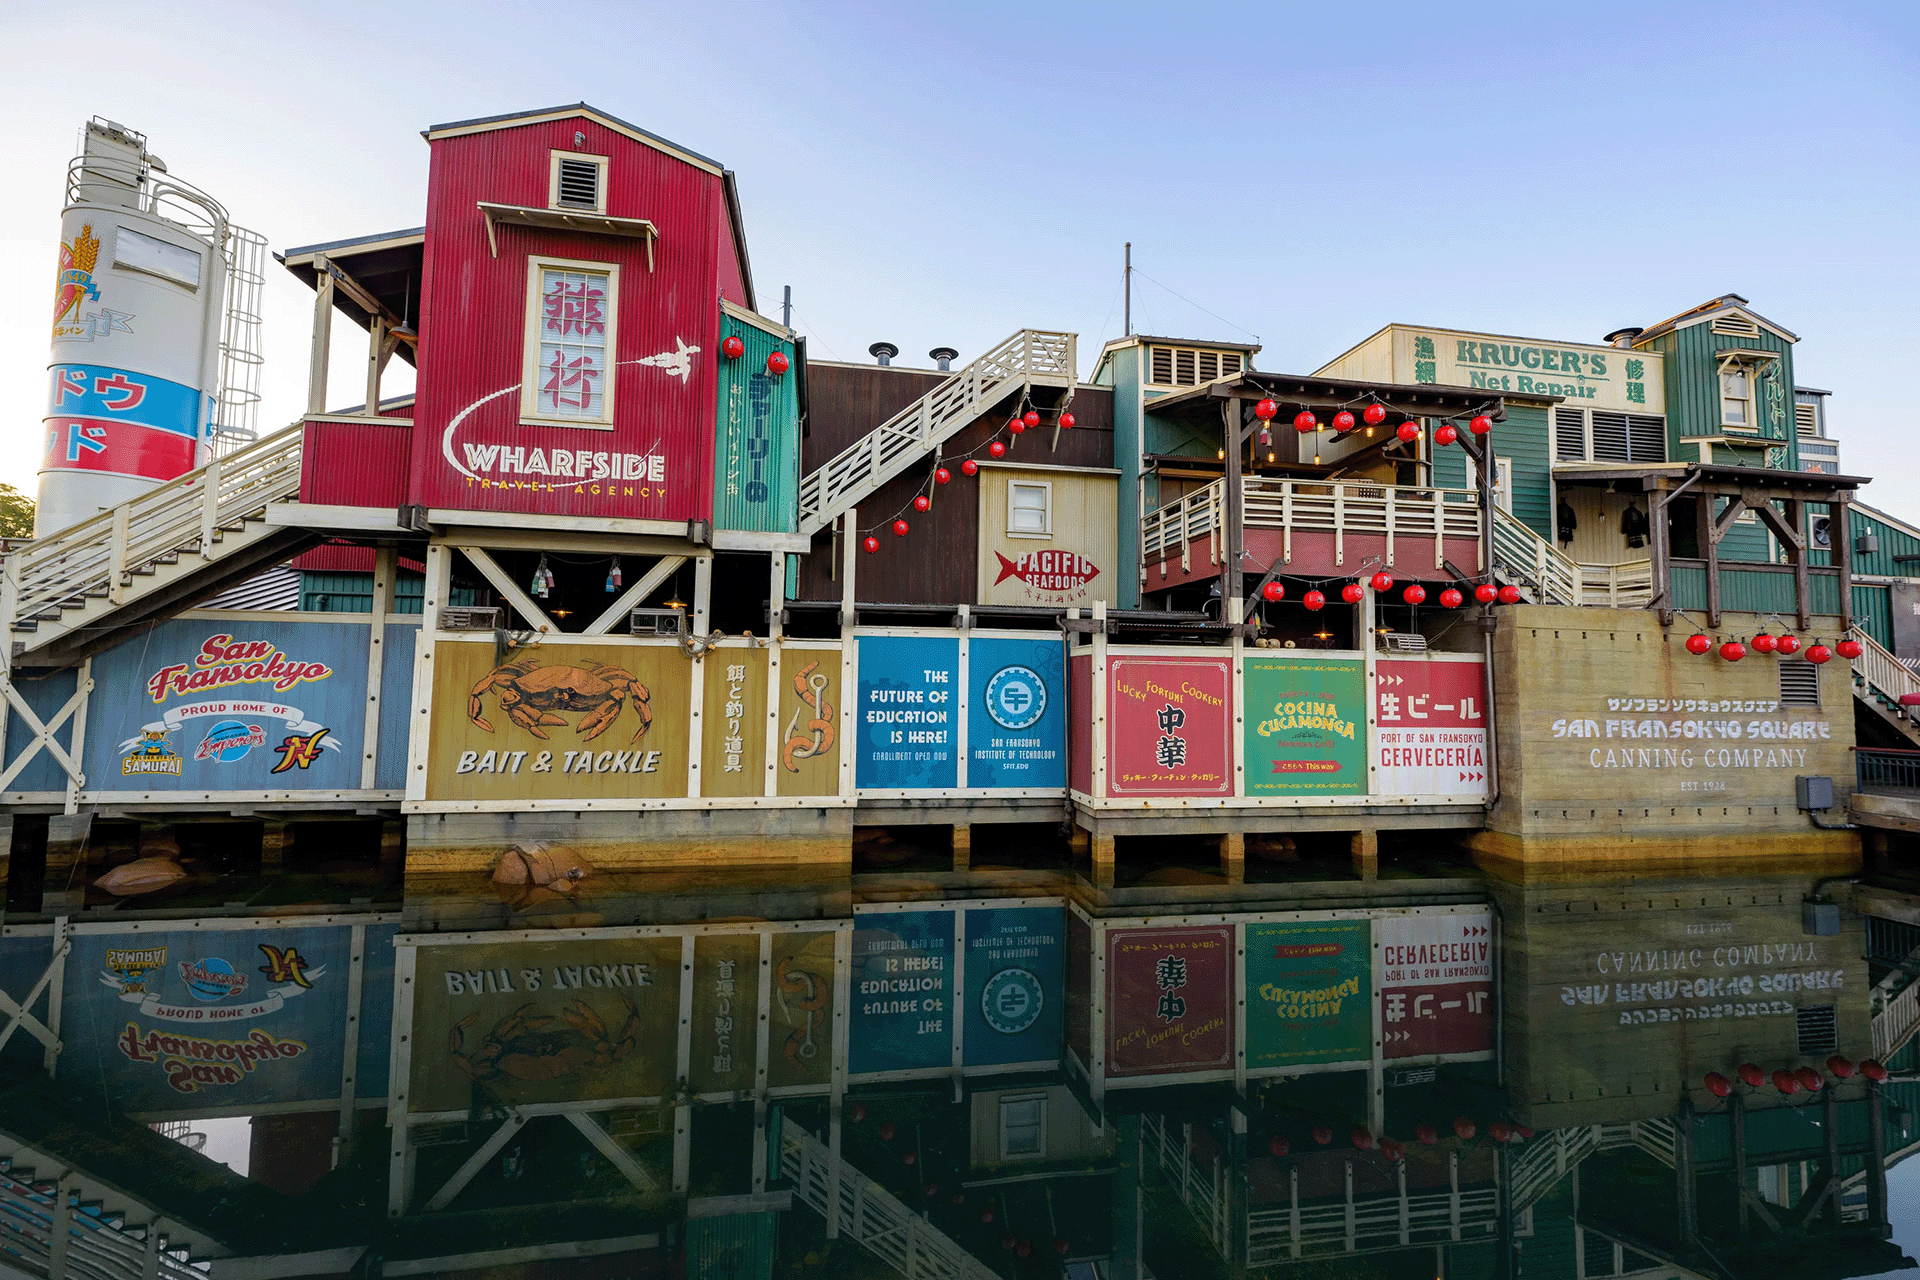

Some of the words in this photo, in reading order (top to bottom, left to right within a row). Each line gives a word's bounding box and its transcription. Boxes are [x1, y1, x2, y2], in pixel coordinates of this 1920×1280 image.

[544, 281, 605, 410] 旅行
[1456, 339, 1607, 376] KRUGER'S
[56, 367, 147, 412] ドウ
[1469, 371, 1510, 391] Net
[1512, 375, 1597, 399] Repair
[1625, 358, 1645, 404] 修理
[463, 442, 665, 483] WHARFSIDE
[466, 477, 555, 493] TRAVEL
[574, 484, 666, 498] AGENCY
[1017, 551, 1092, 575] PACIFIC
[1025, 573, 1086, 589] SEAFOODS
[194, 633, 276, 668] San
[147, 651, 333, 704] Fransokyo
[923, 669, 949, 683] THE
[870, 689, 924, 703] FUTURE
[928, 690, 948, 703] OF
[1380, 692, 1482, 721] 生ビール
[1607, 698, 1778, 713] サンフランソウキョウスクエア
[180, 704, 227, 717] PROUD
[233, 704, 266, 712] HOME
[272, 706, 288, 715] OF
[724, 664, 746, 772] 餌と釣り道具
[866, 710, 947, 723] EDUCATION
[1274, 701, 1339, 719] COCINA
[890, 730, 903, 744] IS
[908, 730, 948, 744] HERE!
[1155, 703, 1187, 769] 中華
[1257, 715, 1356, 740] CUCAMONGA
[1381, 733, 1402, 743] PORT
[1406, 733, 1415, 743] OF
[1419, 733, 1435, 743] SAN
[1439, 733, 1483, 743] FRANSOKYO
[1551, 718, 1601, 738] SAN
[1605, 719, 1742, 739] FRANSOKYO
[1746, 720, 1831, 739] SQUARE
[194, 731, 267, 763] Emperors
[991, 738, 1003, 748] SAN
[455, 750, 528, 774] BAIT
[530, 752, 553, 774] &
[562, 750, 662, 775] TACKLE
[873, 752, 912, 761] ENROLLMENT
[915, 752, 931, 761] OPEN
[974, 750, 1006, 760] INSTITUTE
[1008, 750, 1016, 760] OF
[1019, 750, 1056, 760] TECHNOLOGY
[1381, 744, 1484, 767] CERVECERÍA
[1590, 748, 1694, 768] CANNING
[1704, 748, 1807, 768] COMPANY
[125, 759, 181, 774] SAMURAI
